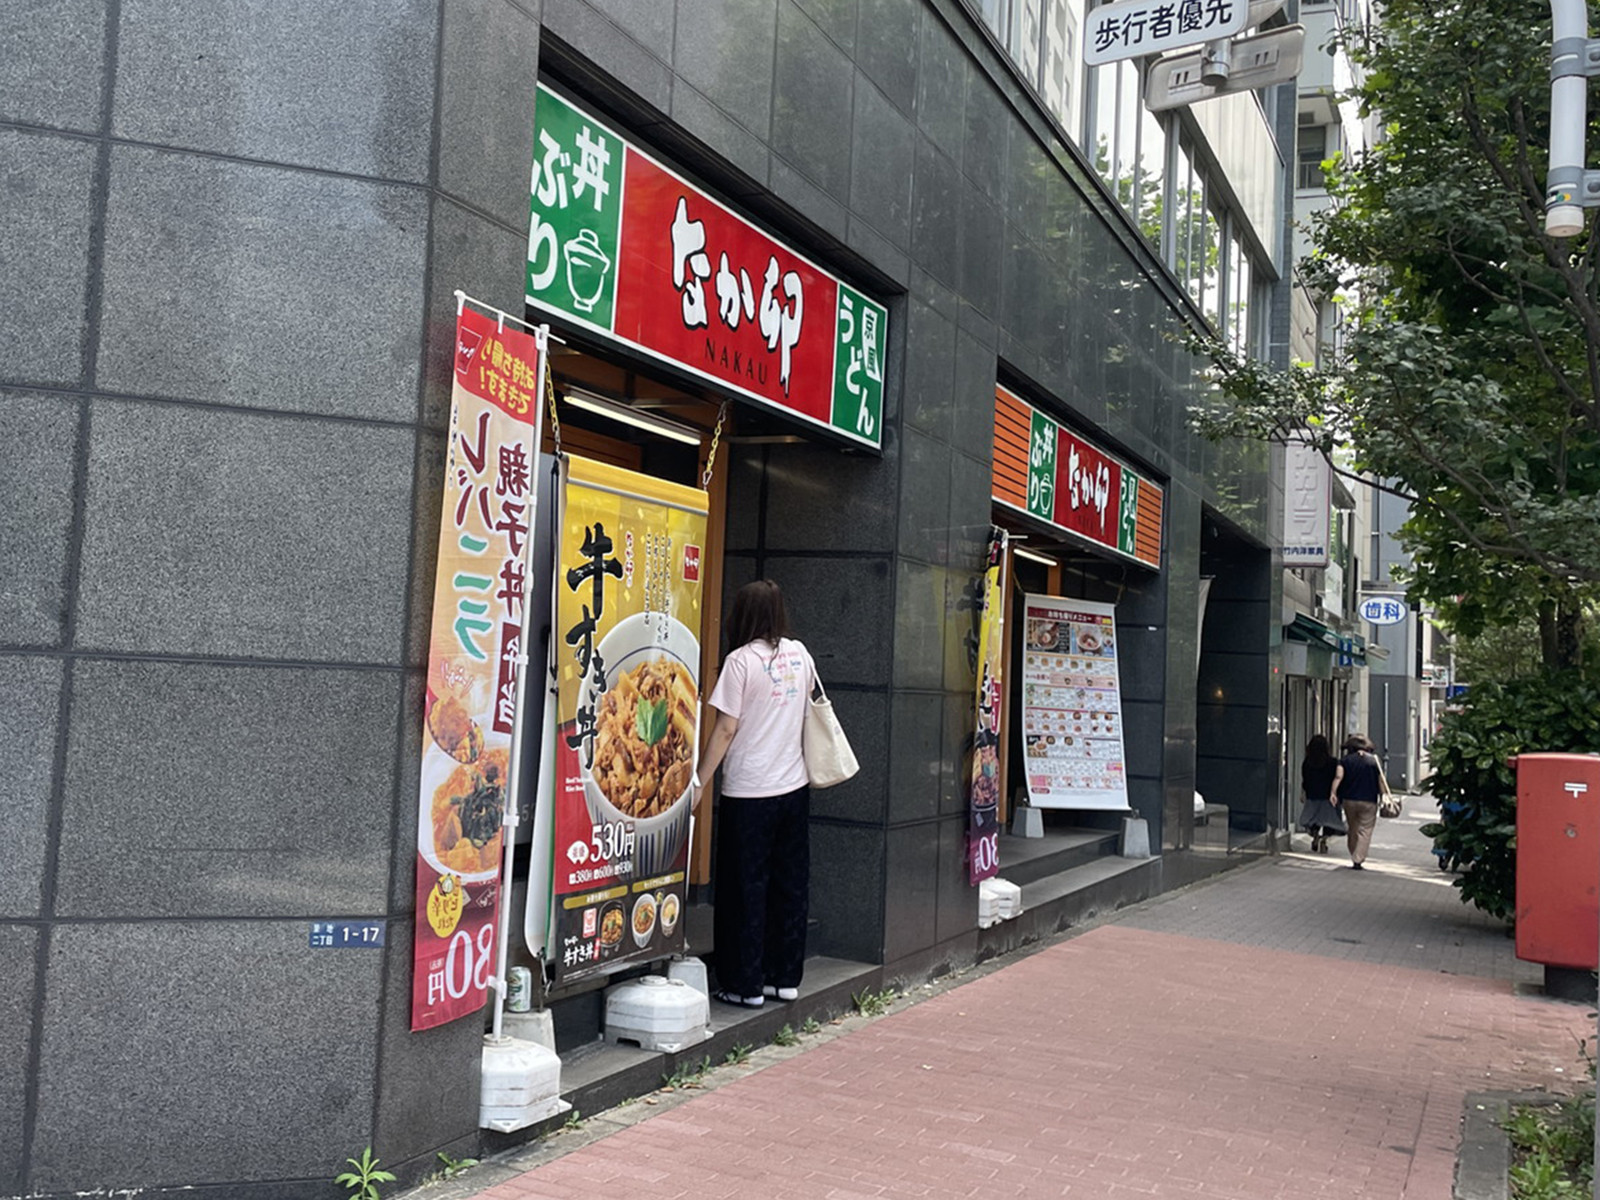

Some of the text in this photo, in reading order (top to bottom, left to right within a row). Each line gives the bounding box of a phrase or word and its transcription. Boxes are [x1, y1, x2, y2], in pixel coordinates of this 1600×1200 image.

[1095, 0, 1232, 52] 歩行者優先
[671, 197, 802, 397] なか卯
[704, 337, 768, 385] NAKAU
[839, 294, 876, 437] うどん
[1068, 442, 1111, 537] なか卯
[1365, 602, 1400, 620] 歯科
[565, 521, 624, 771] 牛すき丼
[591, 821, 635, 863] 530円
[342, 927, 380, 942] 1-17
